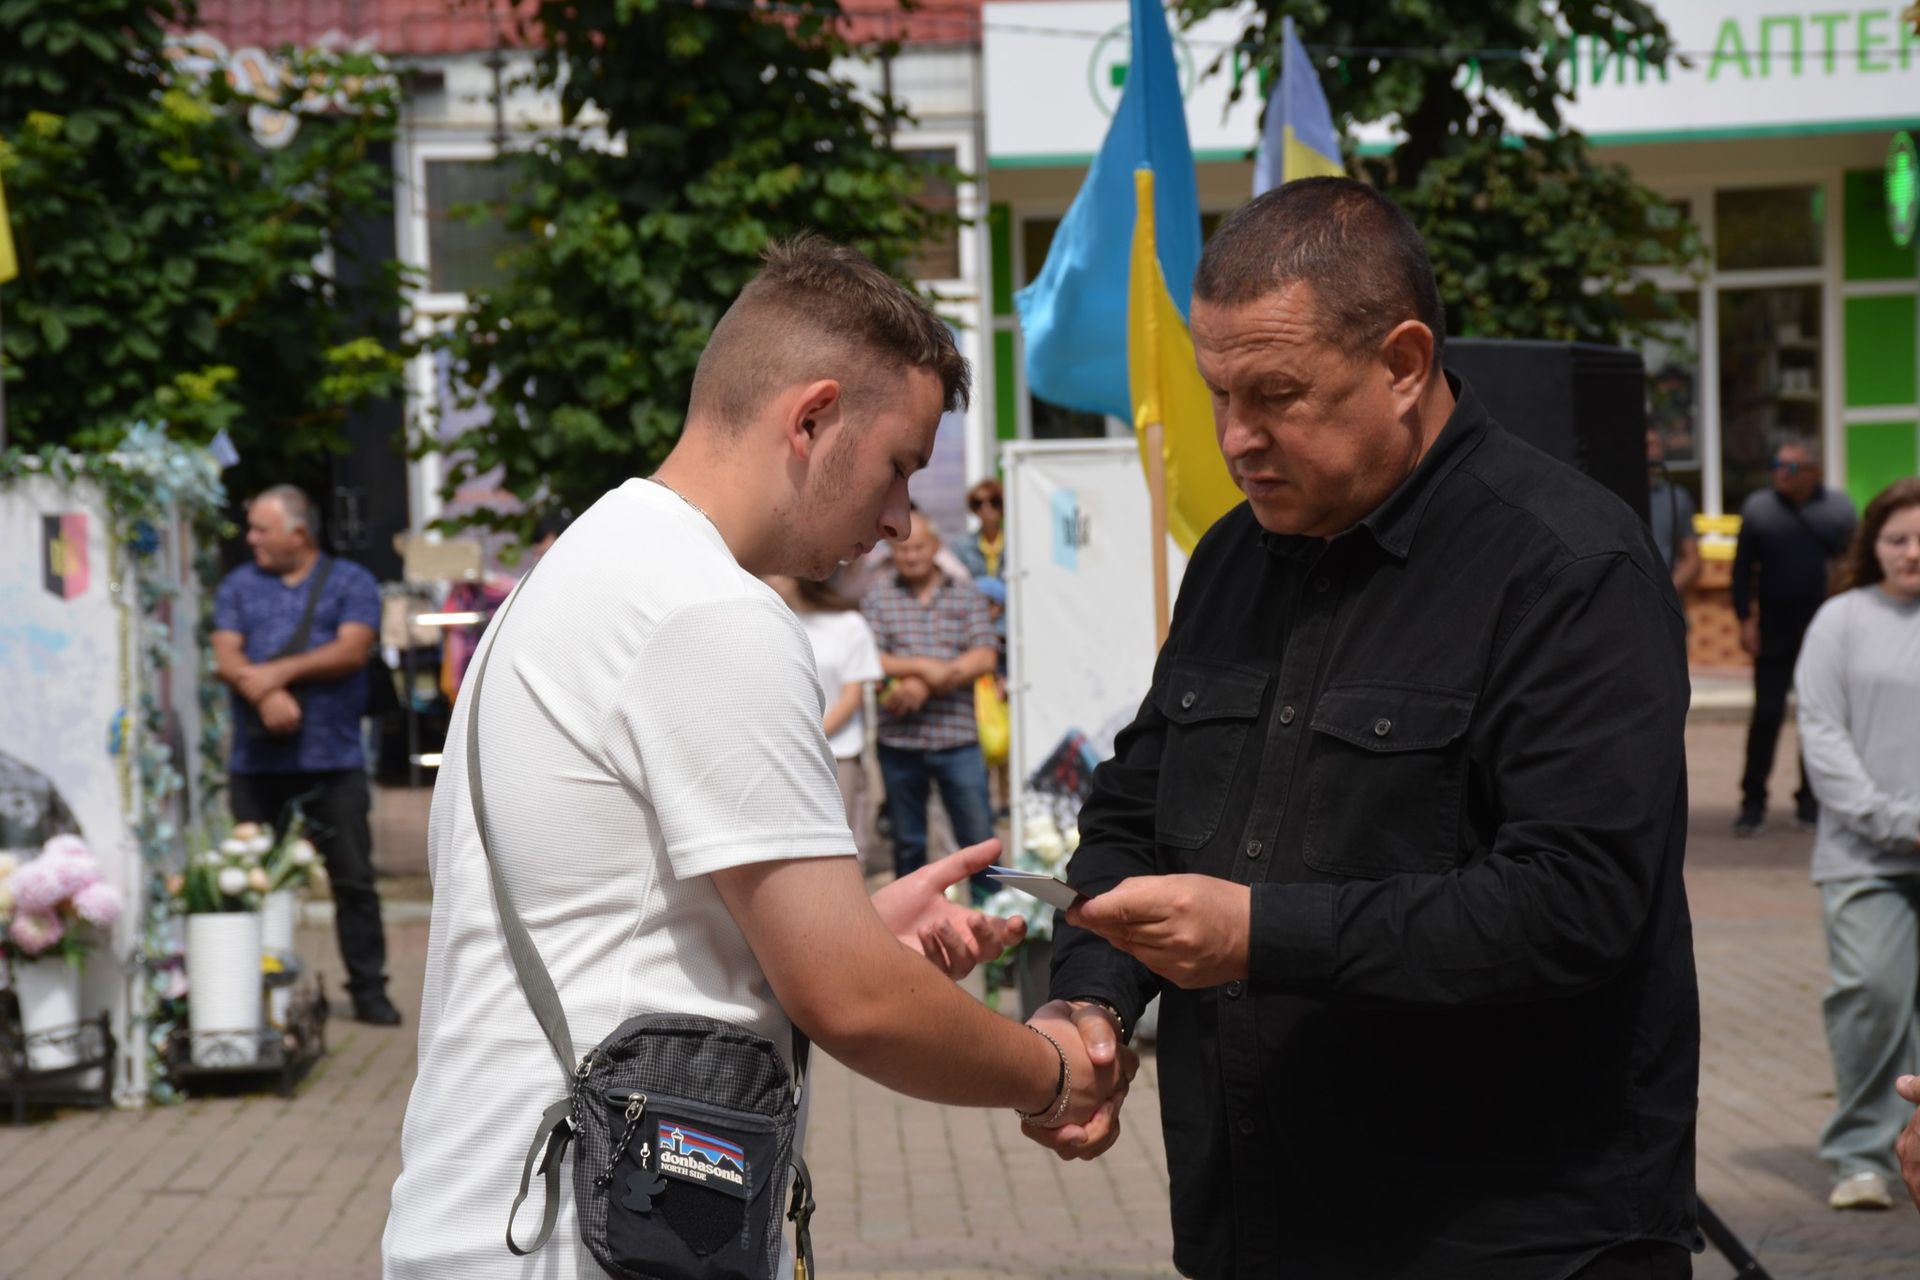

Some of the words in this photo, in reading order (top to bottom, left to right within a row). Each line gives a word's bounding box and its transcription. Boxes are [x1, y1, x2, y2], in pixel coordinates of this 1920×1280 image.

[660, 1150, 743, 1185] donbasonia
[660, 1162, 689, 1176] NORTH
[689, 1171, 707, 1181] SIDE
